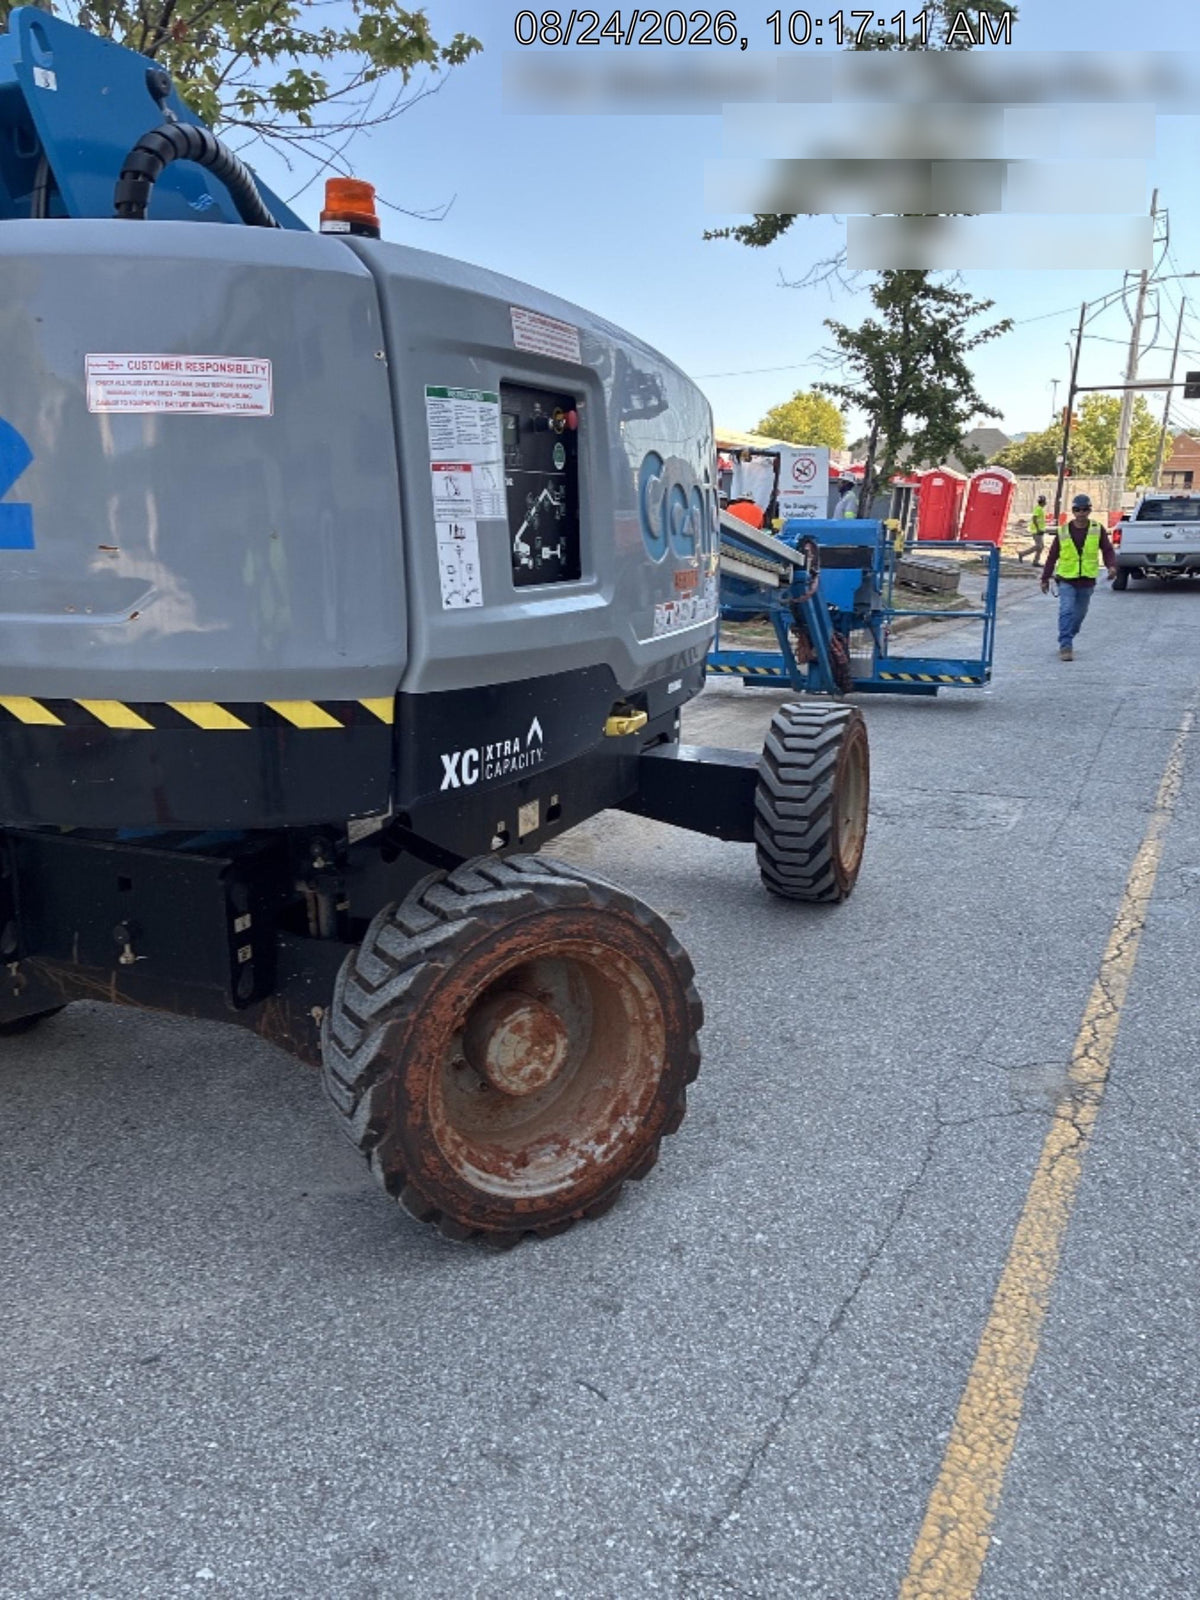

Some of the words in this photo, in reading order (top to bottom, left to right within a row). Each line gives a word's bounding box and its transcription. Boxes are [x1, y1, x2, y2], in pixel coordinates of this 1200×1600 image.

[127, 360, 183, 371] CUSTOMER
[185, 361, 267, 374] RESPONSIBILITY
[486, 737, 520, 761] XTRA
[440, 748, 479, 791] XC
[485, 748, 543, 780] CAPACITY
